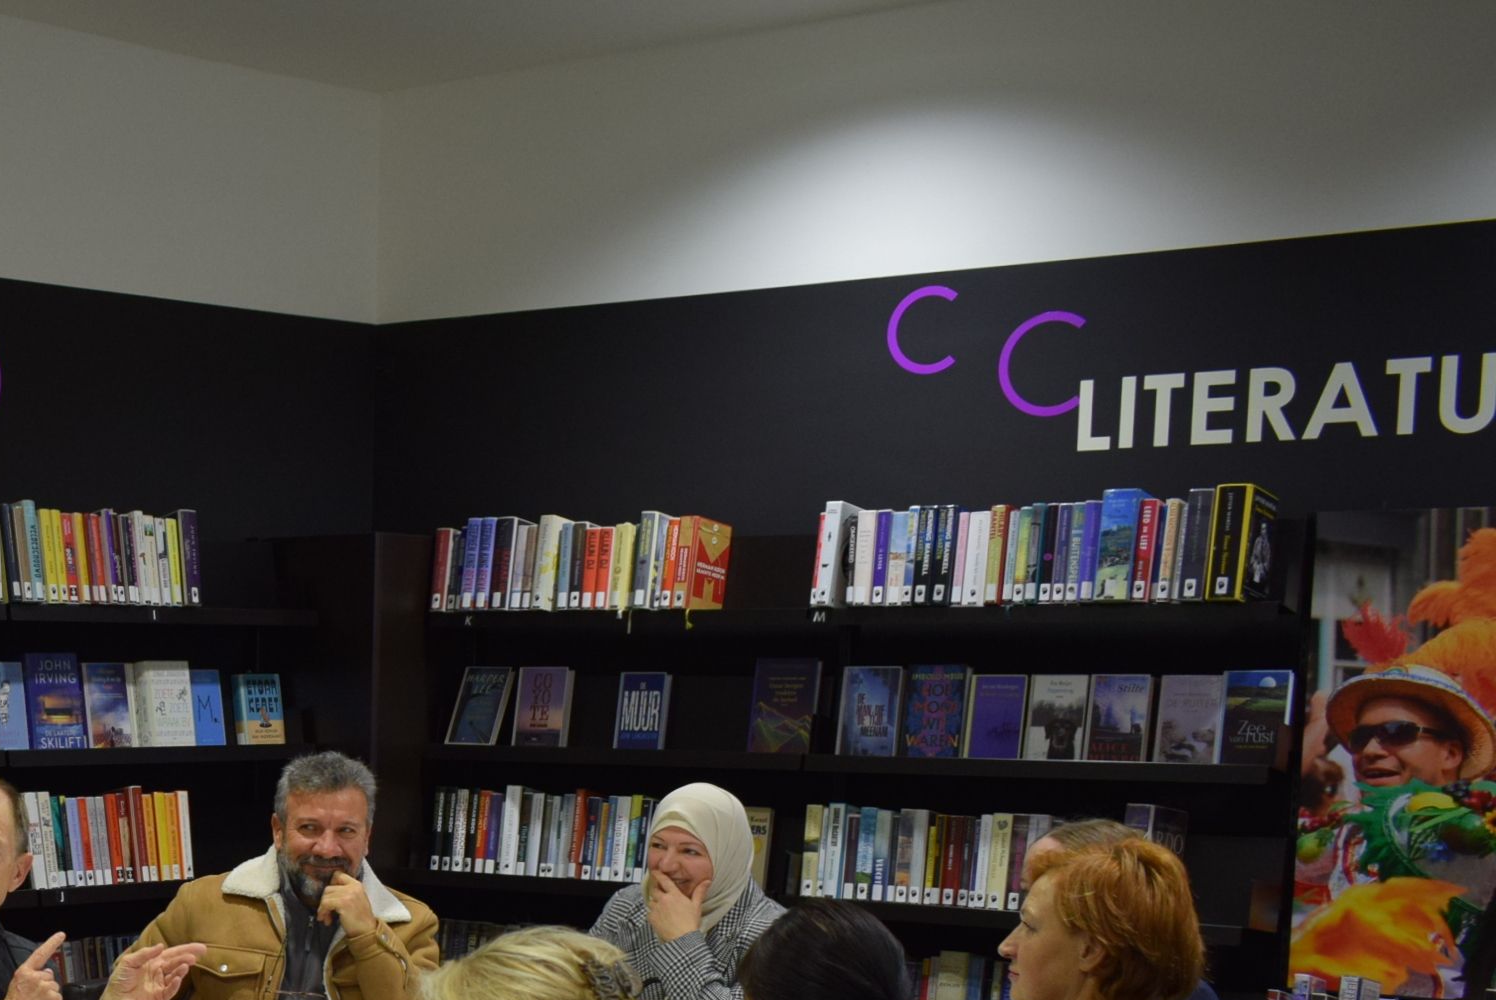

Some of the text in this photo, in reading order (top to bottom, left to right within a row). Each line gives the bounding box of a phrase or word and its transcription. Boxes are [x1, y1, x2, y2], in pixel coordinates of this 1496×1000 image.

[1077, 352, 1496, 452] LITERATU
[989, 510, 998, 540] MANTEL
[599, 531, 610, 568] KLUUN DJ
[922, 510, 935, 575] HENNING MANKELL
[941, 509, 954, 575] HENNING MANKELL
[587, 532, 597, 569] KLUUN DJ
[37, 659, 72, 672] JOHN
[34, 673, 77, 684] IRVING
[466, 674, 505, 684] HARPER
[534, 673, 553, 689] CO
[246, 679, 279, 695] ETGAR
[1117, 682, 1146, 693] Stilte
[248, 697, 281, 713] KERET
[532, 689, 551, 705] YO
[196, 695, 219, 723] M.
[529, 705, 550, 721] TE
[620, 690, 661, 731] MUUR
[1237, 719, 1267, 735] Zee
[40, 735, 82, 749] SKILIFT
[905, 734, 960, 748] WAREN
[1228, 730, 1276, 743] van rust
[613, 839, 621, 865] VROLIJK
